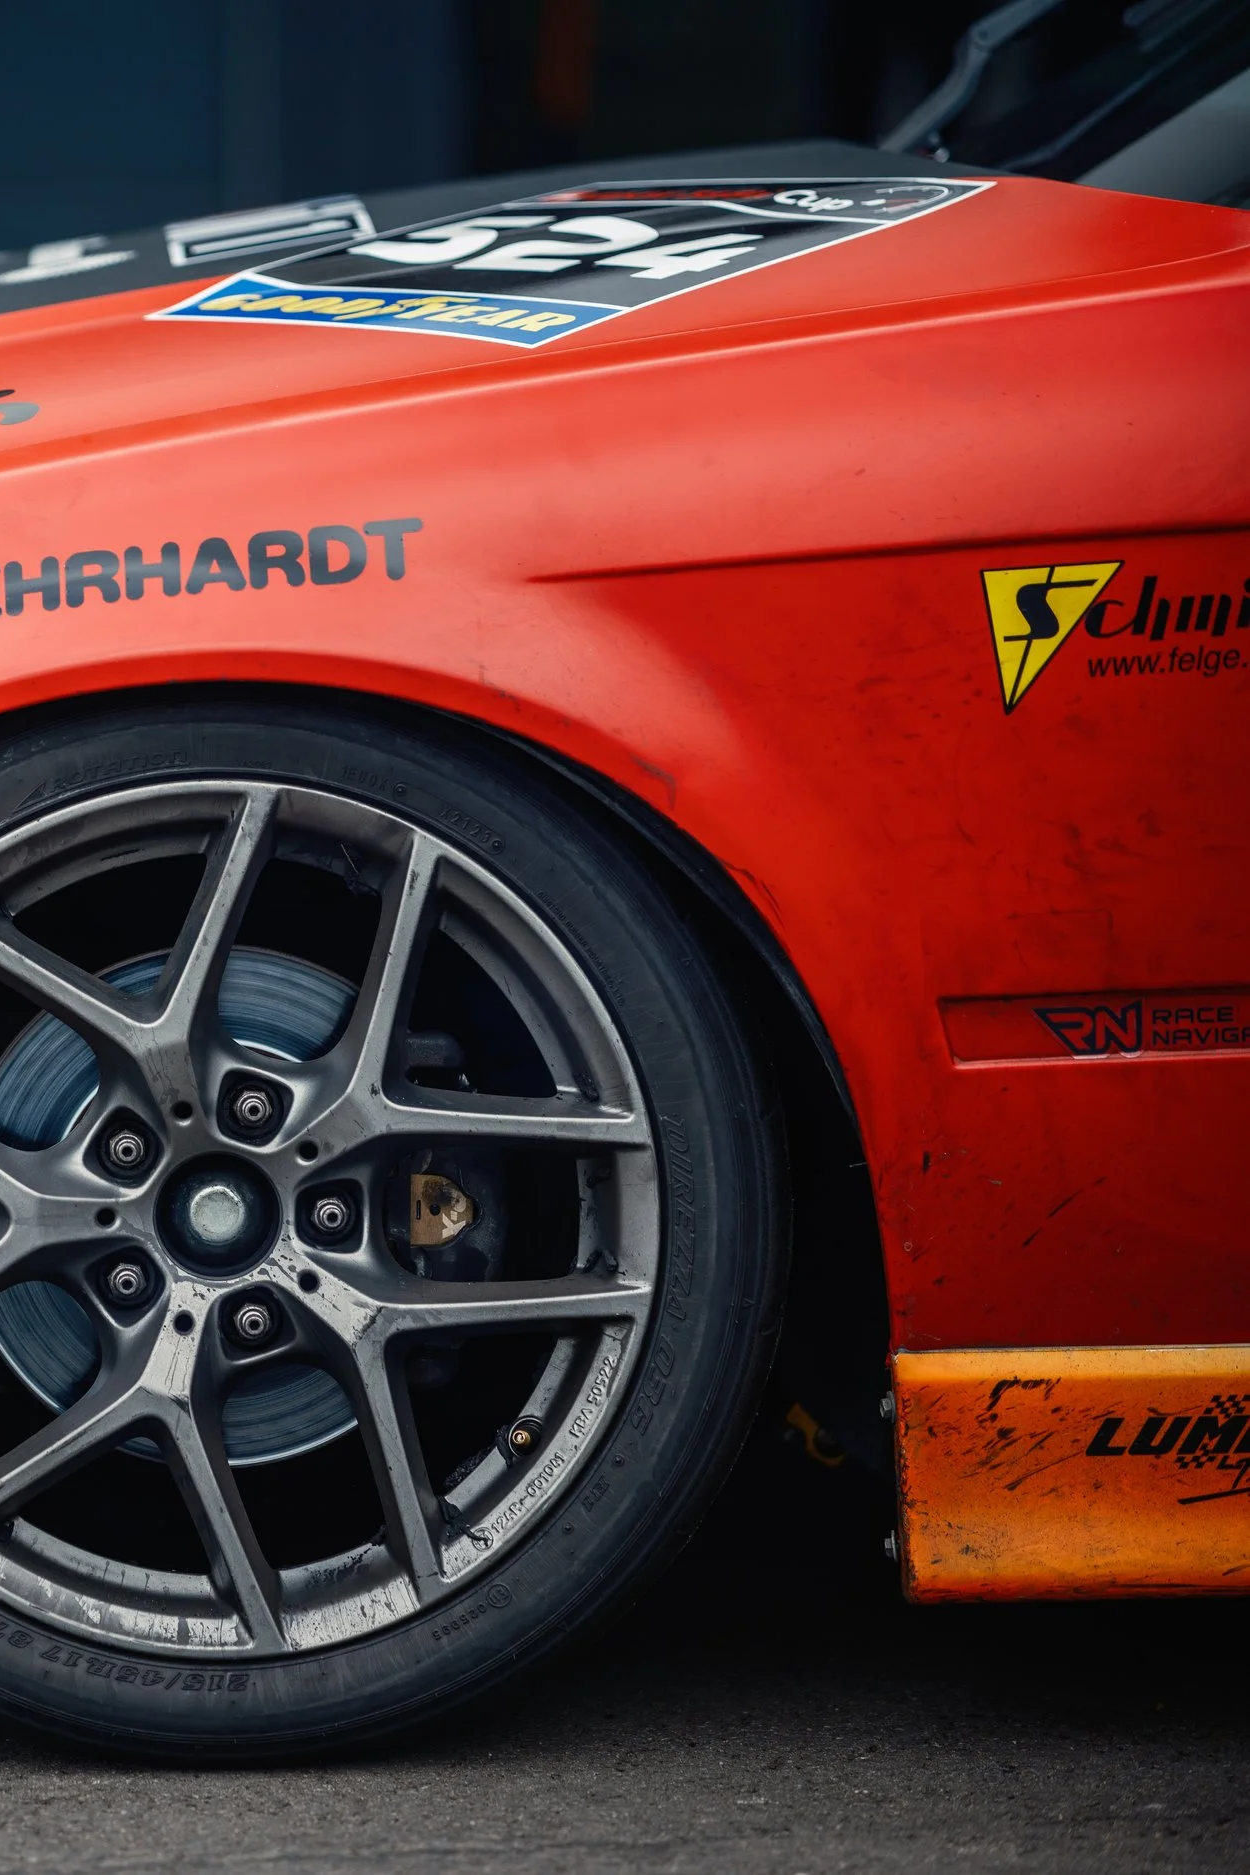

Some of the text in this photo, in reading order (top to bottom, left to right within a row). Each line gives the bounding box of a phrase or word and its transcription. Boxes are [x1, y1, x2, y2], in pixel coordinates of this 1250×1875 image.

[772, 187, 854, 214] Cup
[346, 214, 764, 280] 524
[198, 293, 576, 334] GOODYEAR
[1152, 1006, 1234, 1026] RACE
[665, 1113, 695, 1321] DIREZZA
[584, 1354, 616, 1406] 50522
[39, 1642, 250, 1693] 215/45R17
